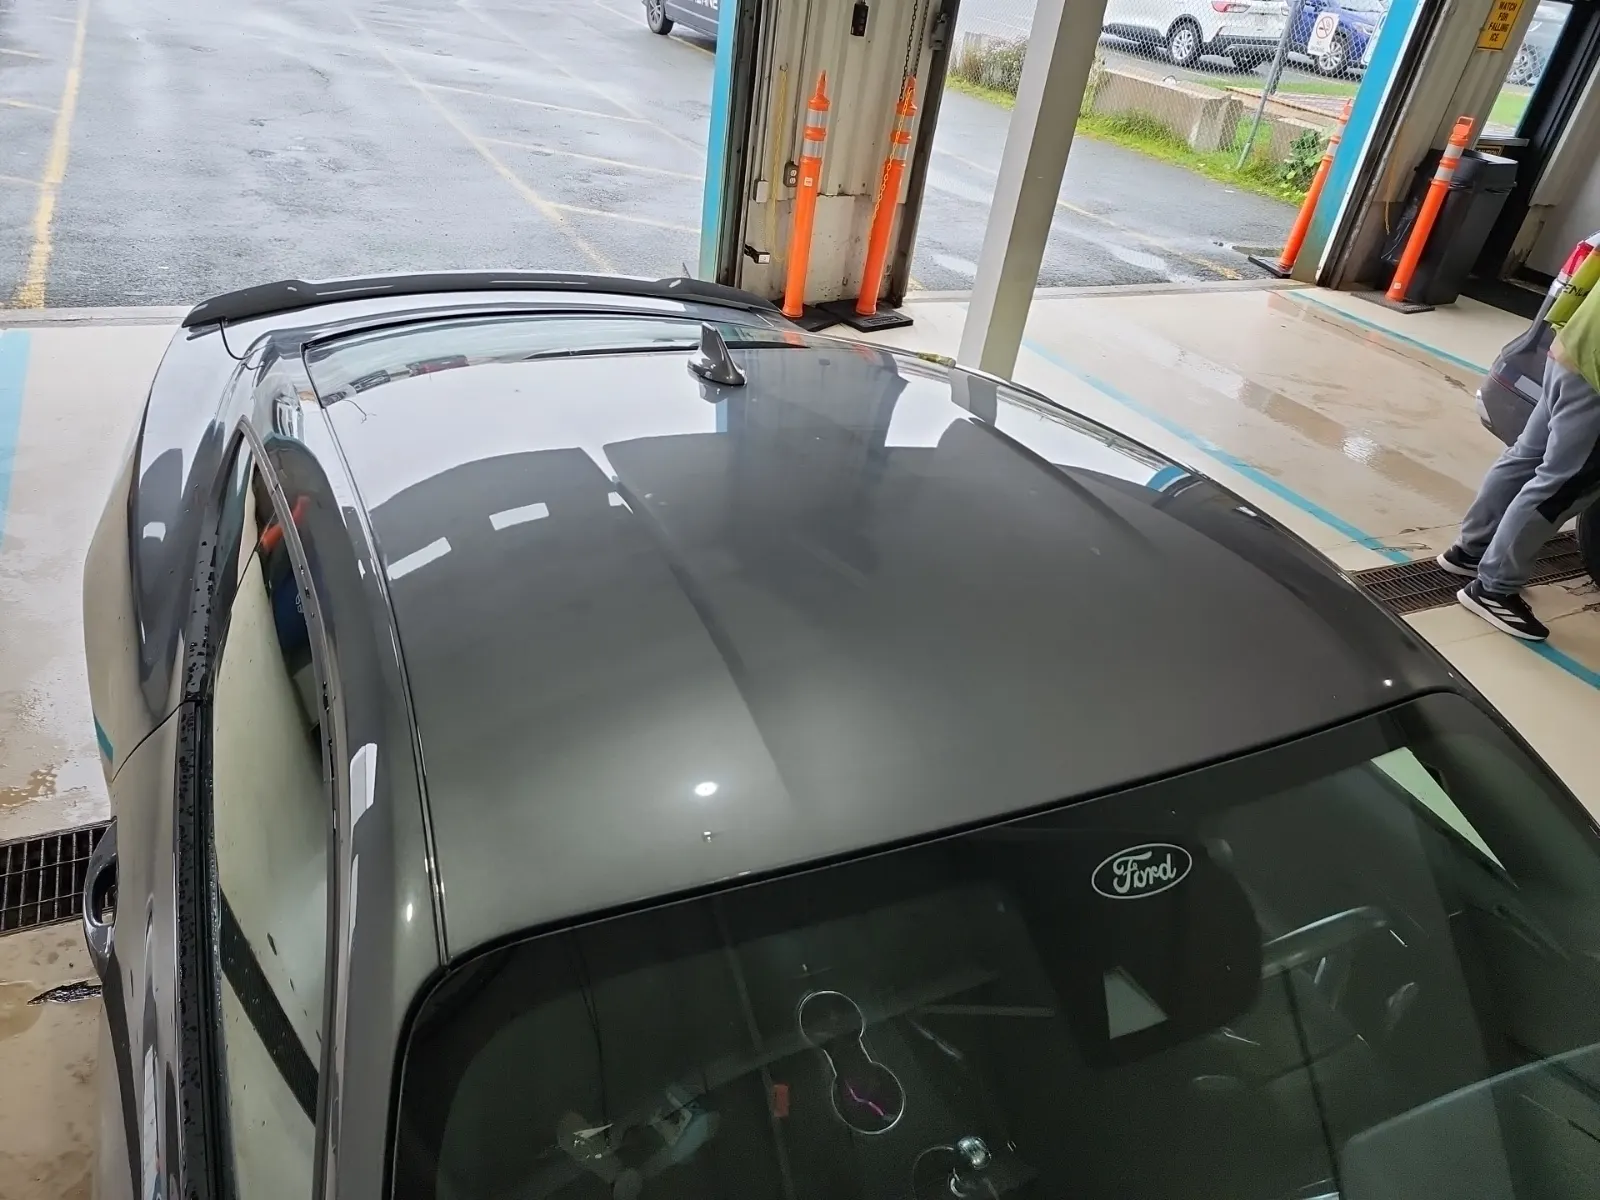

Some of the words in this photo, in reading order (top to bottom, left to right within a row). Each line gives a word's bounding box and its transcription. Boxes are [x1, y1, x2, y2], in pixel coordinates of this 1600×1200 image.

[1499, 2, 1518, 11] WATCH
[1497, 12, 1509, 21] FOR
[1488, 22, 1510, 32] FALLING
[1489, 33, 1500, 42] ICE
[1112, 850, 1177, 893] Ford
